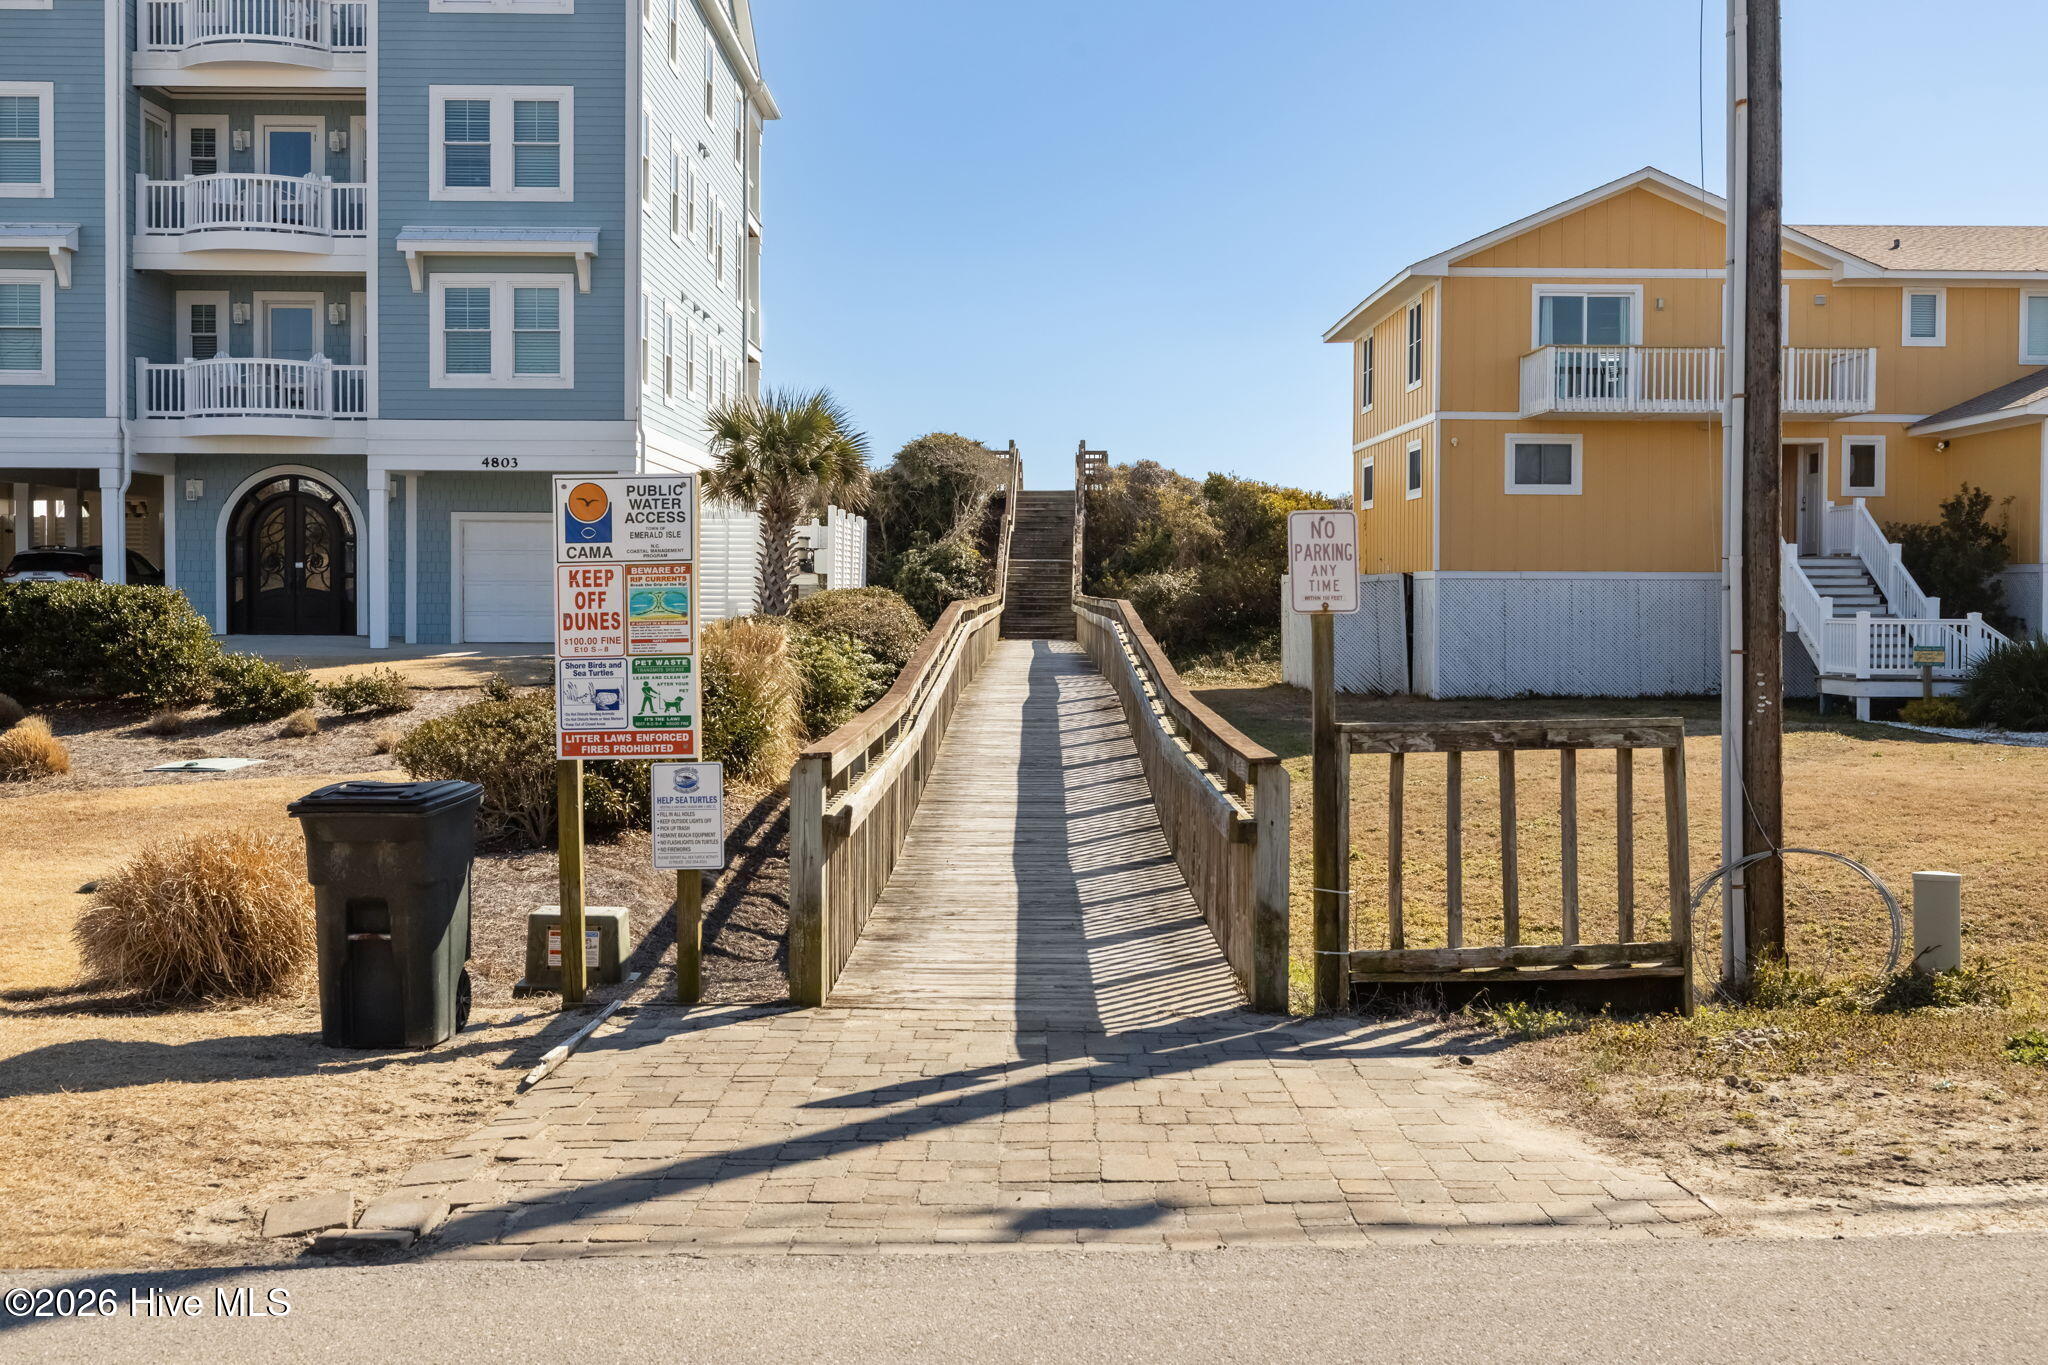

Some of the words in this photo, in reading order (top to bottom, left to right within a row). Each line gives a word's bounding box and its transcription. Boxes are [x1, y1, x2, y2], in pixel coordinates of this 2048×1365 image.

[481, 456, 518, 468] 4803
[626, 484, 683, 497] PUBLIC
[628, 498, 682, 510] WATER
[624, 512, 686, 524] ACCESS
[1311, 520, 1335, 539] NO
[566, 546, 613, 559] CAMA
[1294, 543, 1352, 561] PARKING
[1311, 565, 1337, 576] ANY
[568, 569, 614, 588] KEEP
[1309, 580, 1340, 592] TIME
[574, 591, 606, 610] OFF
[563, 612, 621, 631] DUNES
[564, 637, 598, 645] $100.00
[566, 734, 600, 743] LITTER
[604, 734, 632, 742] LAWS
[636, 733, 689, 742] ENFORCED
[581, 745, 610, 754] FIRES
[614, 744, 674, 753] PROHIBITED
